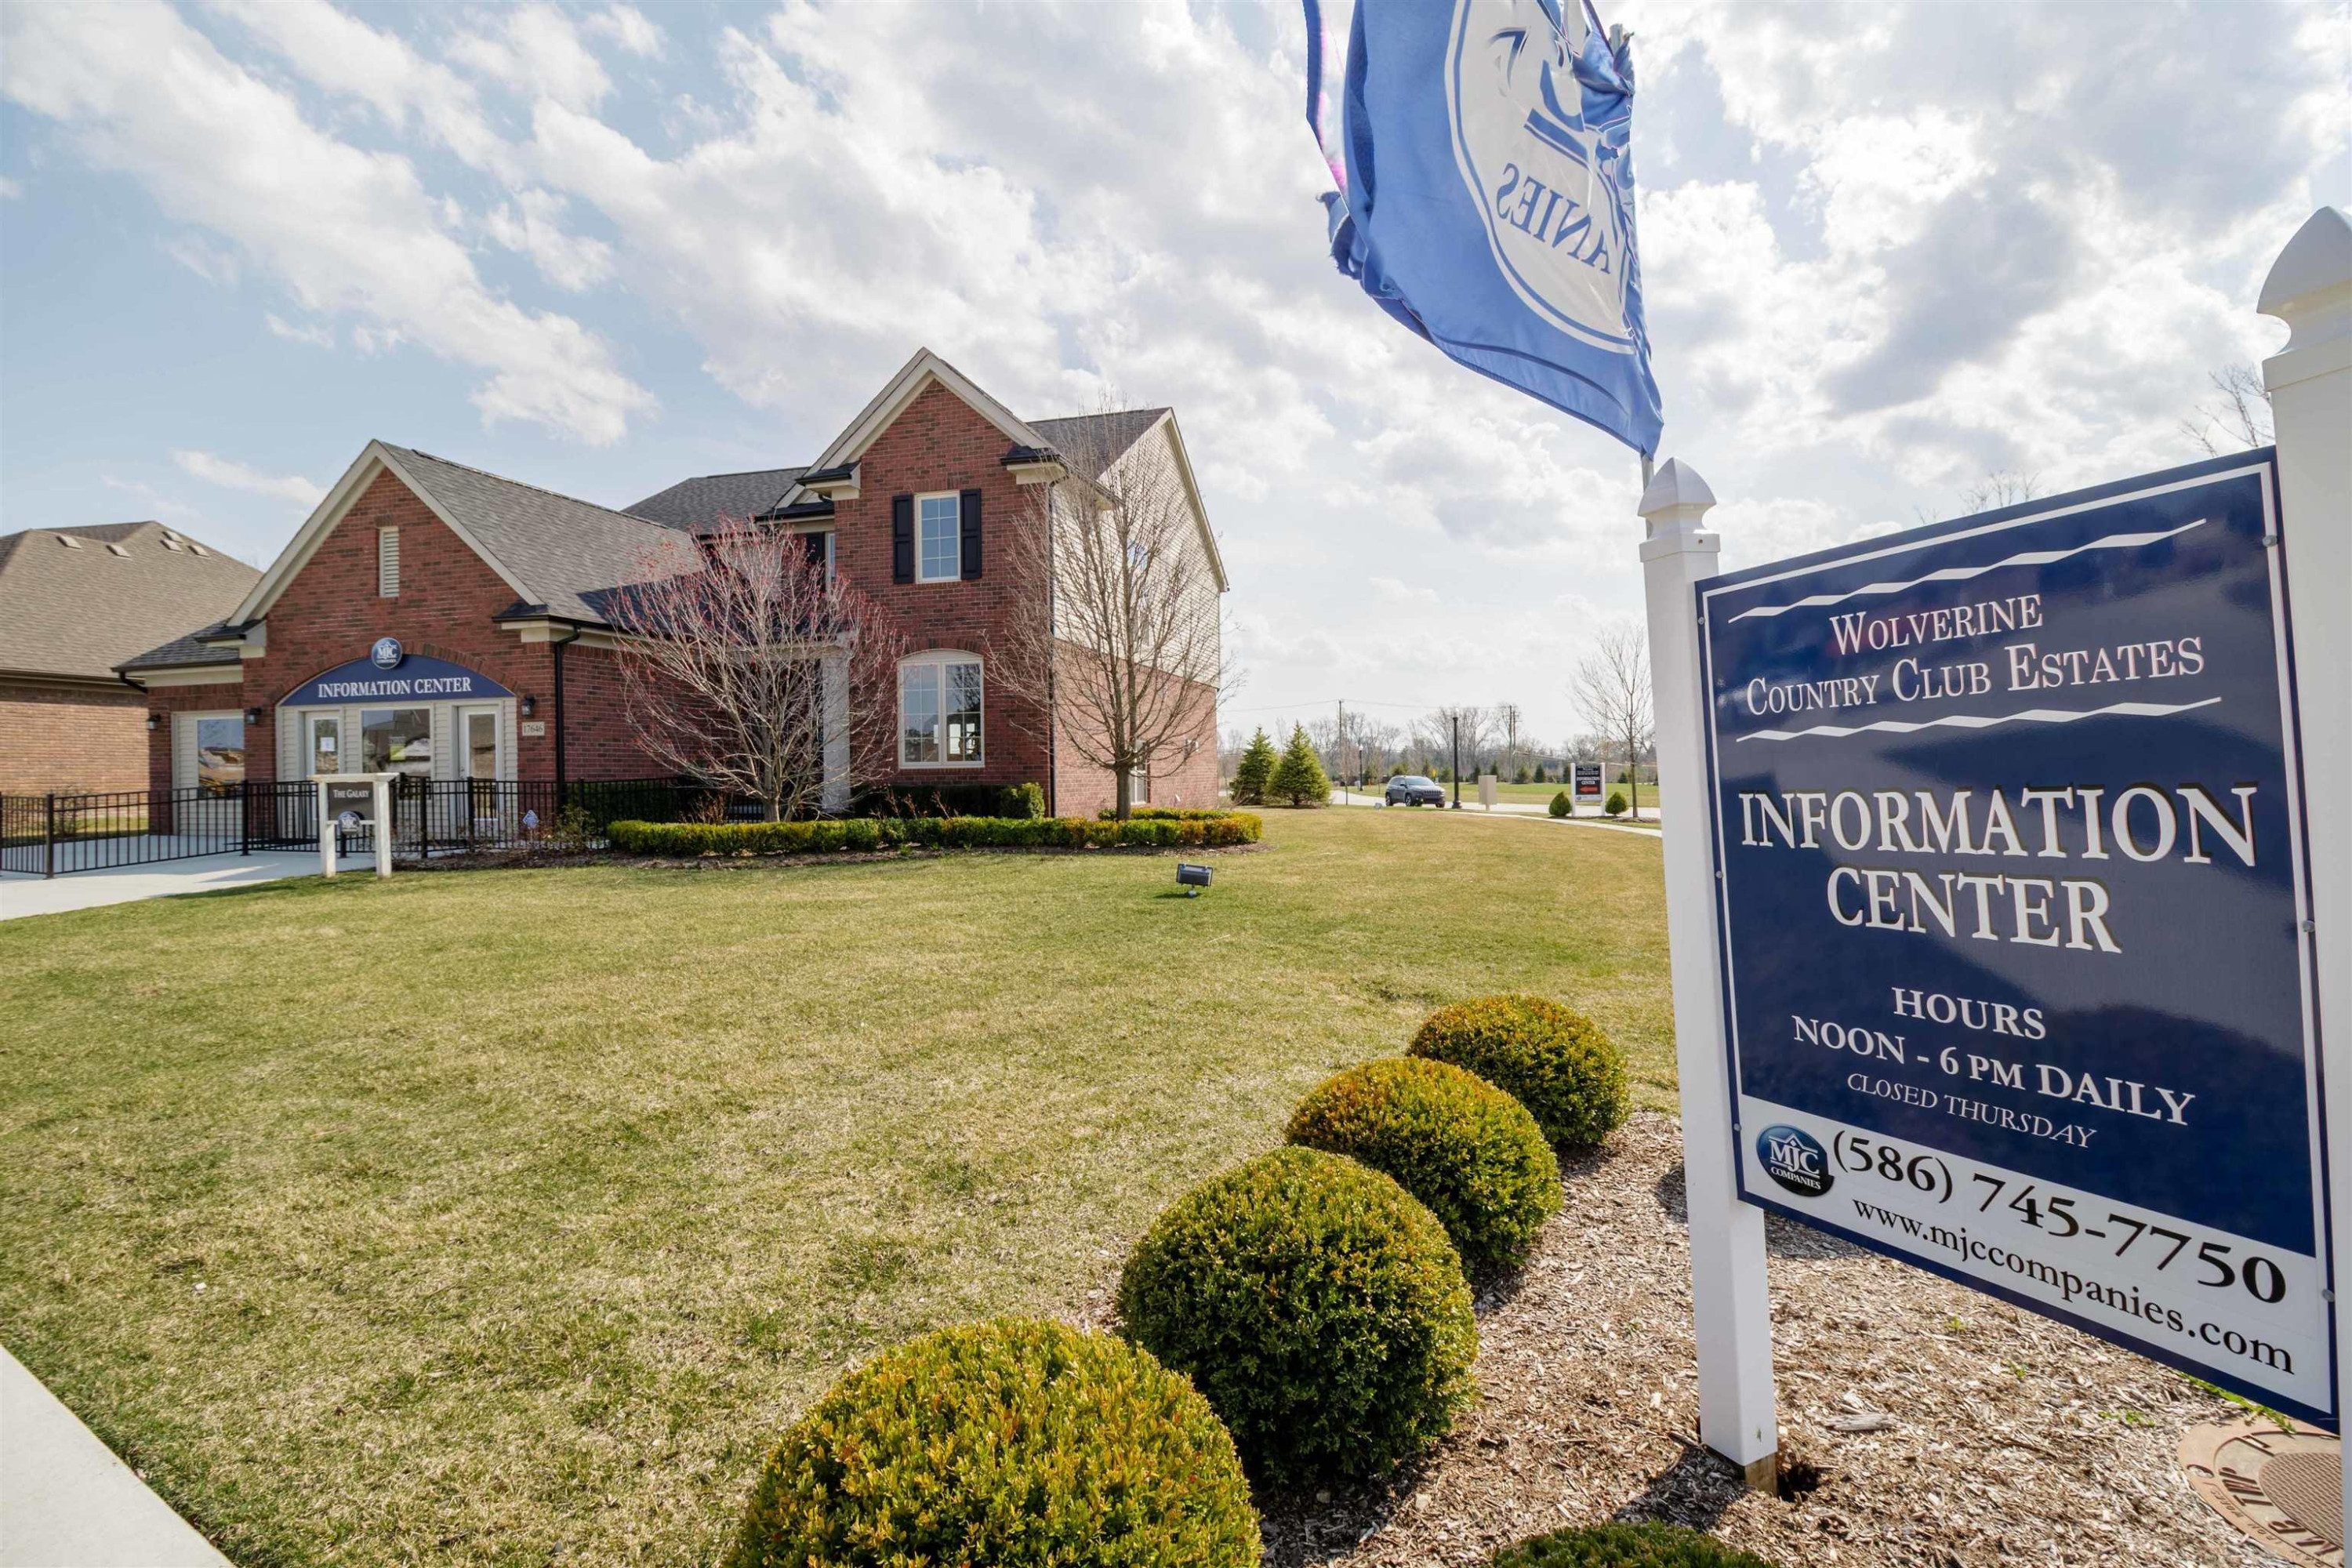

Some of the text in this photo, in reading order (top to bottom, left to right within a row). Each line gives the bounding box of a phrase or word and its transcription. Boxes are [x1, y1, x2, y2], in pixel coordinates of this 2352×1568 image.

[1830, 594, 2043, 655] WOLVERINE
[318, 677, 472, 698] INFORMATION CENTER
[1747, 637, 2204, 716] COUNTRY CLUB ESTATES
[523, 724, 543, 734] 17646
[333, 789, 369, 798] THE GALAXY
[1739, 787, 2257, 866] INFORMATION
[1828, 867, 2122, 954] CENTER
[1892, 987, 2046, 1040] HOURS
[1791, 1015, 1905, 1065] NOON
[1940, 1047, 1959, 1075] 6
[1969, 1056, 2025, 1090] PM
[2036, 1065, 2195, 1127] DAILY
[1847, 1073, 2096, 1149] CLOSED THURSDAY
[1769, 1139, 1819, 1174] MJC
[1771, 1167, 1821, 1189] COMPANIES
[1834, 1130, 2287, 1305] (586) 745-7750
[1853, 1199, 2295, 1375] www.mjccompanies.com
